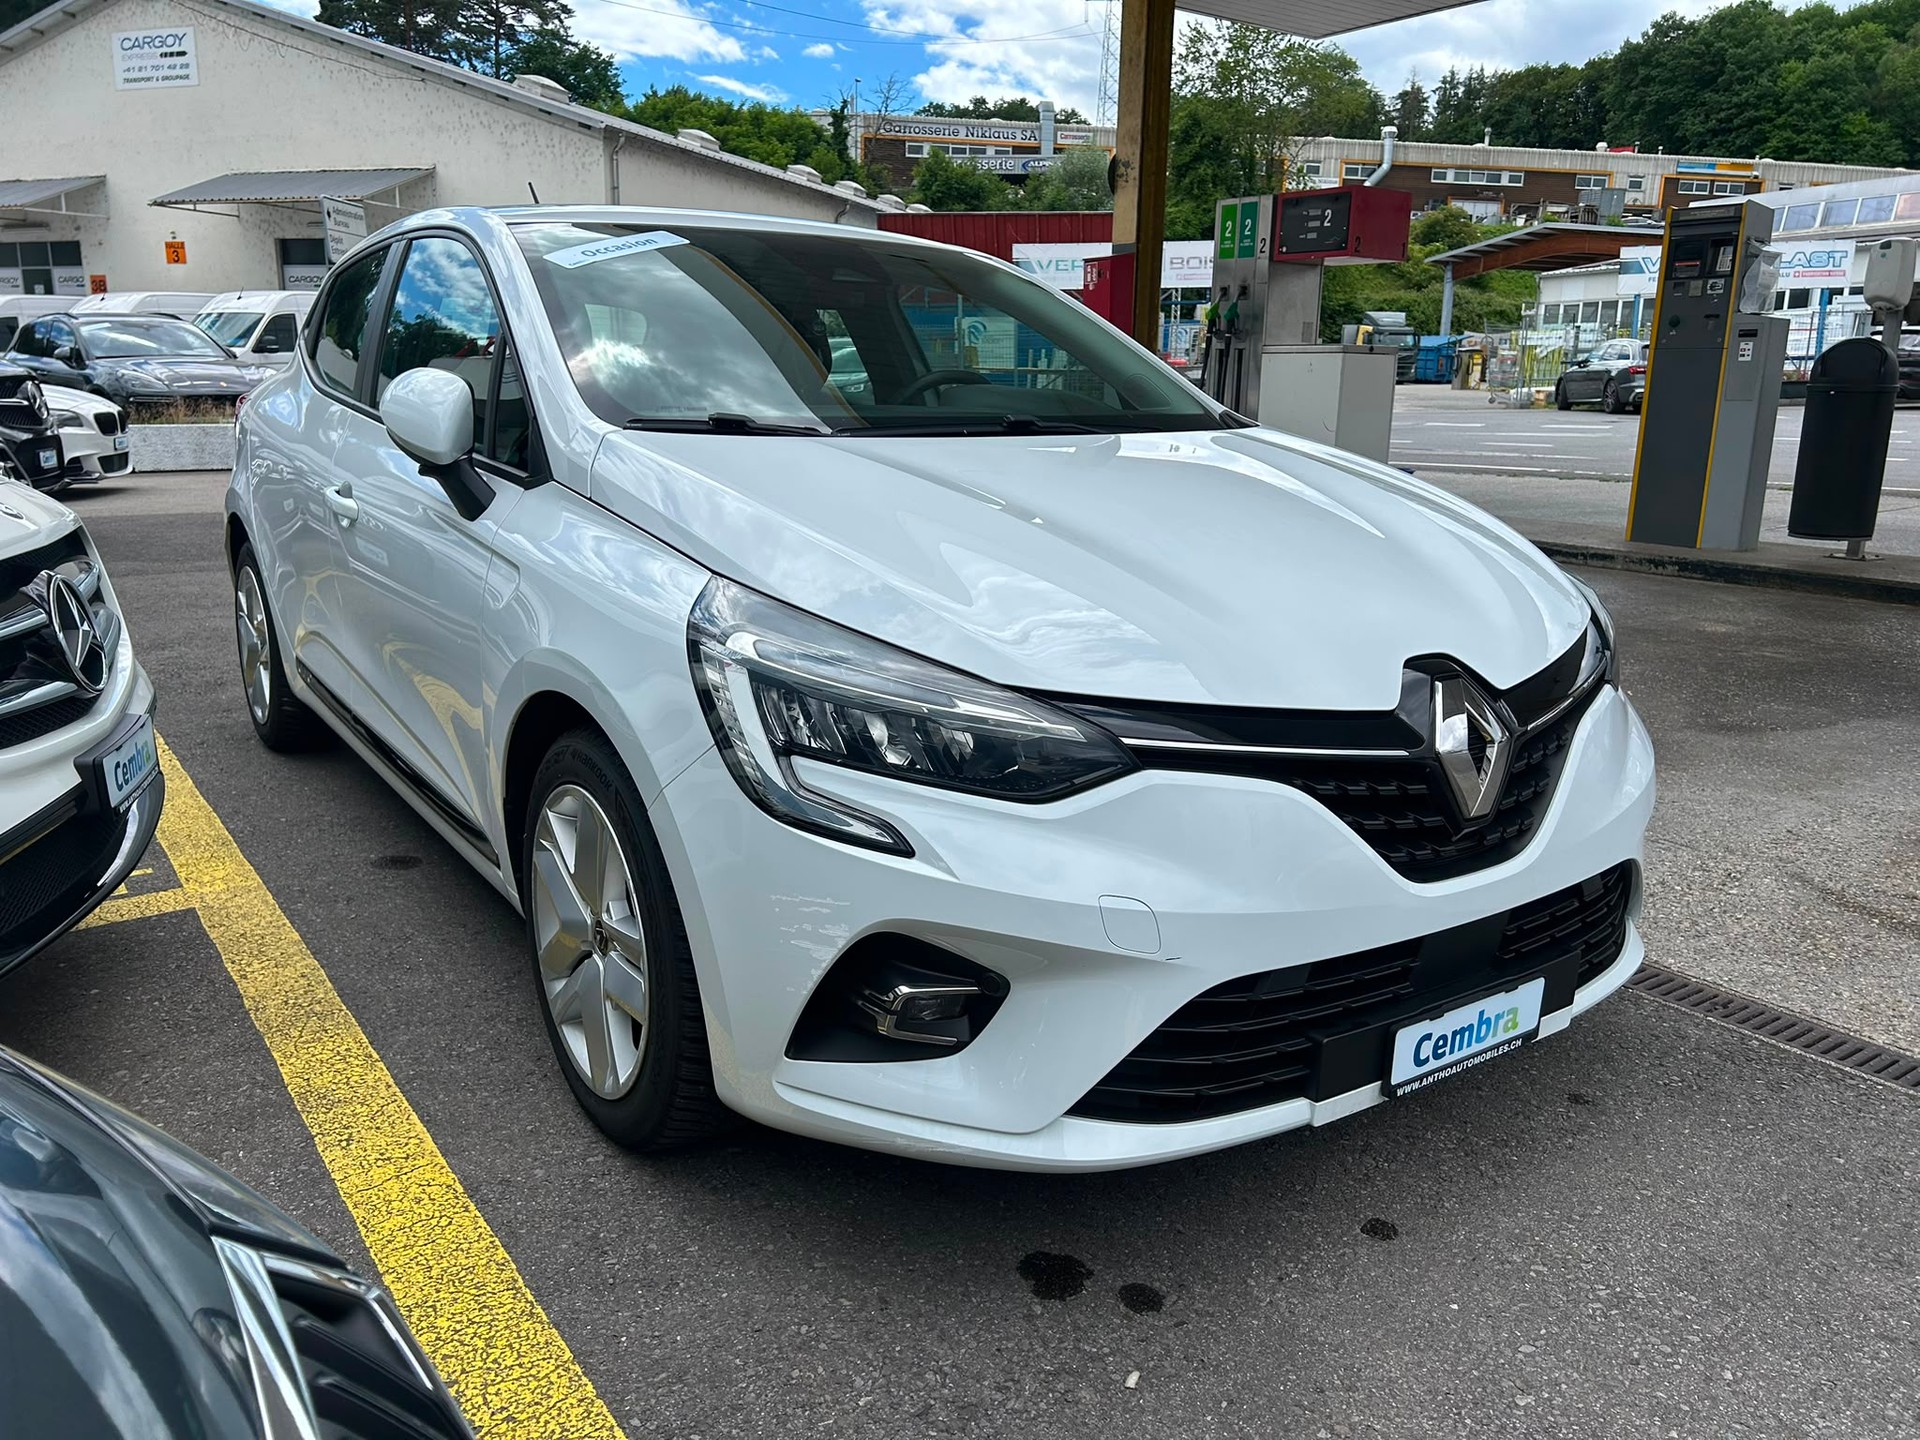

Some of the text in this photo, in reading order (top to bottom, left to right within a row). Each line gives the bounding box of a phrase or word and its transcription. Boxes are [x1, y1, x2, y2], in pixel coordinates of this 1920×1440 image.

[121, 33, 187, 51] CARGOY
[150, 64, 165, 72] 701
[122, 76, 155, 84] TRANSPORT
[883, 121, 1038, 142] Carrosserie Niklaus SA
[1244, 218, 1252, 235] 2
[1323, 208, 1332, 227] 2
[1225, 220, 1233, 237] 2
[581, 238, 658, 256] Occasion
[1259, 237, 1267, 254] 2
[1354, 235, 1362, 253] 2
[172, 249, 180, 263] 3
[58, 275, 85, 284] CARGO
[114, 740, 151, 792] Cembra
[1413, 1006, 1519, 1068] Cembra
[1396, 1037, 1523, 1097] WWW.ANTHOAUTOMOBILES.CH
